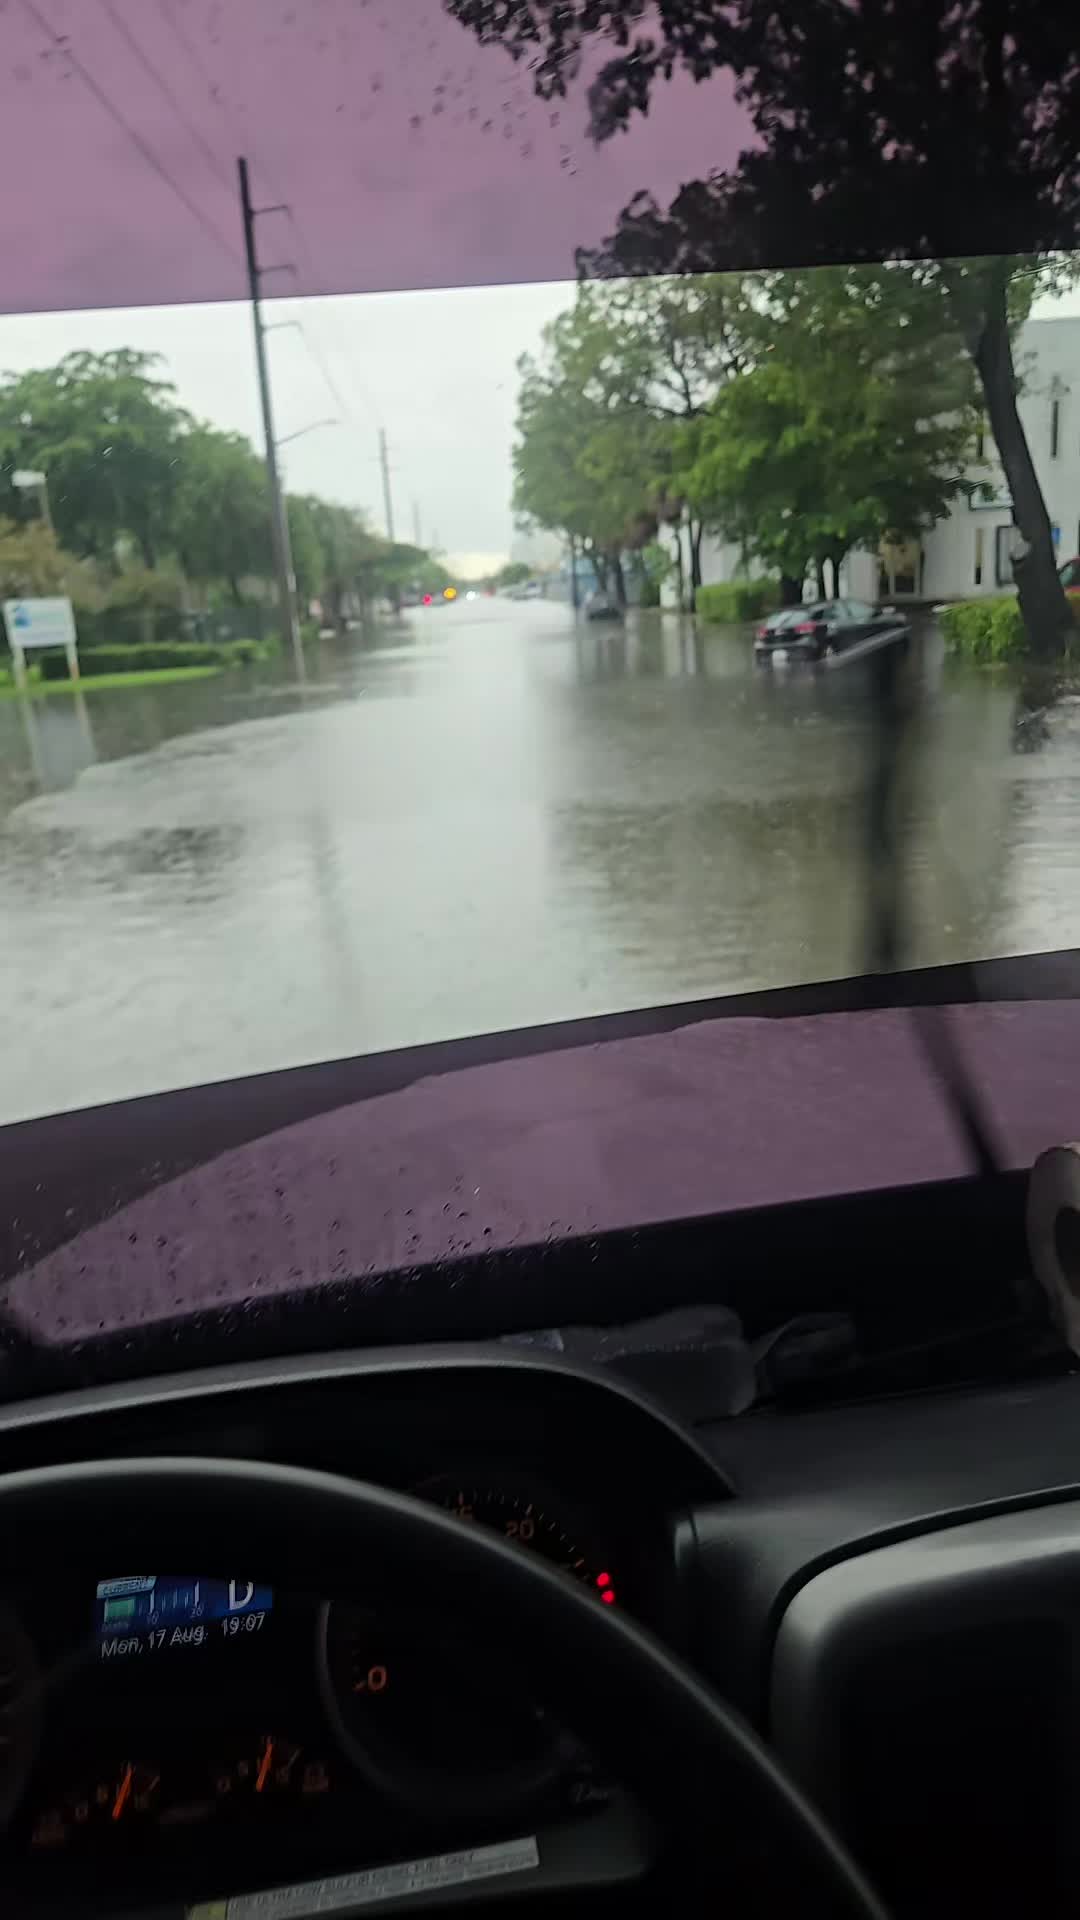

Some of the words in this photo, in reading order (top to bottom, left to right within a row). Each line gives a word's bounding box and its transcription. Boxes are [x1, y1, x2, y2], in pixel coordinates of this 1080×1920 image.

[505, 1519, 535, 1539] 20
[228, 1579, 254, 1611] D
[149, 1629, 167, 1650] 17
[221, 1612, 266, 1636] 19:07
